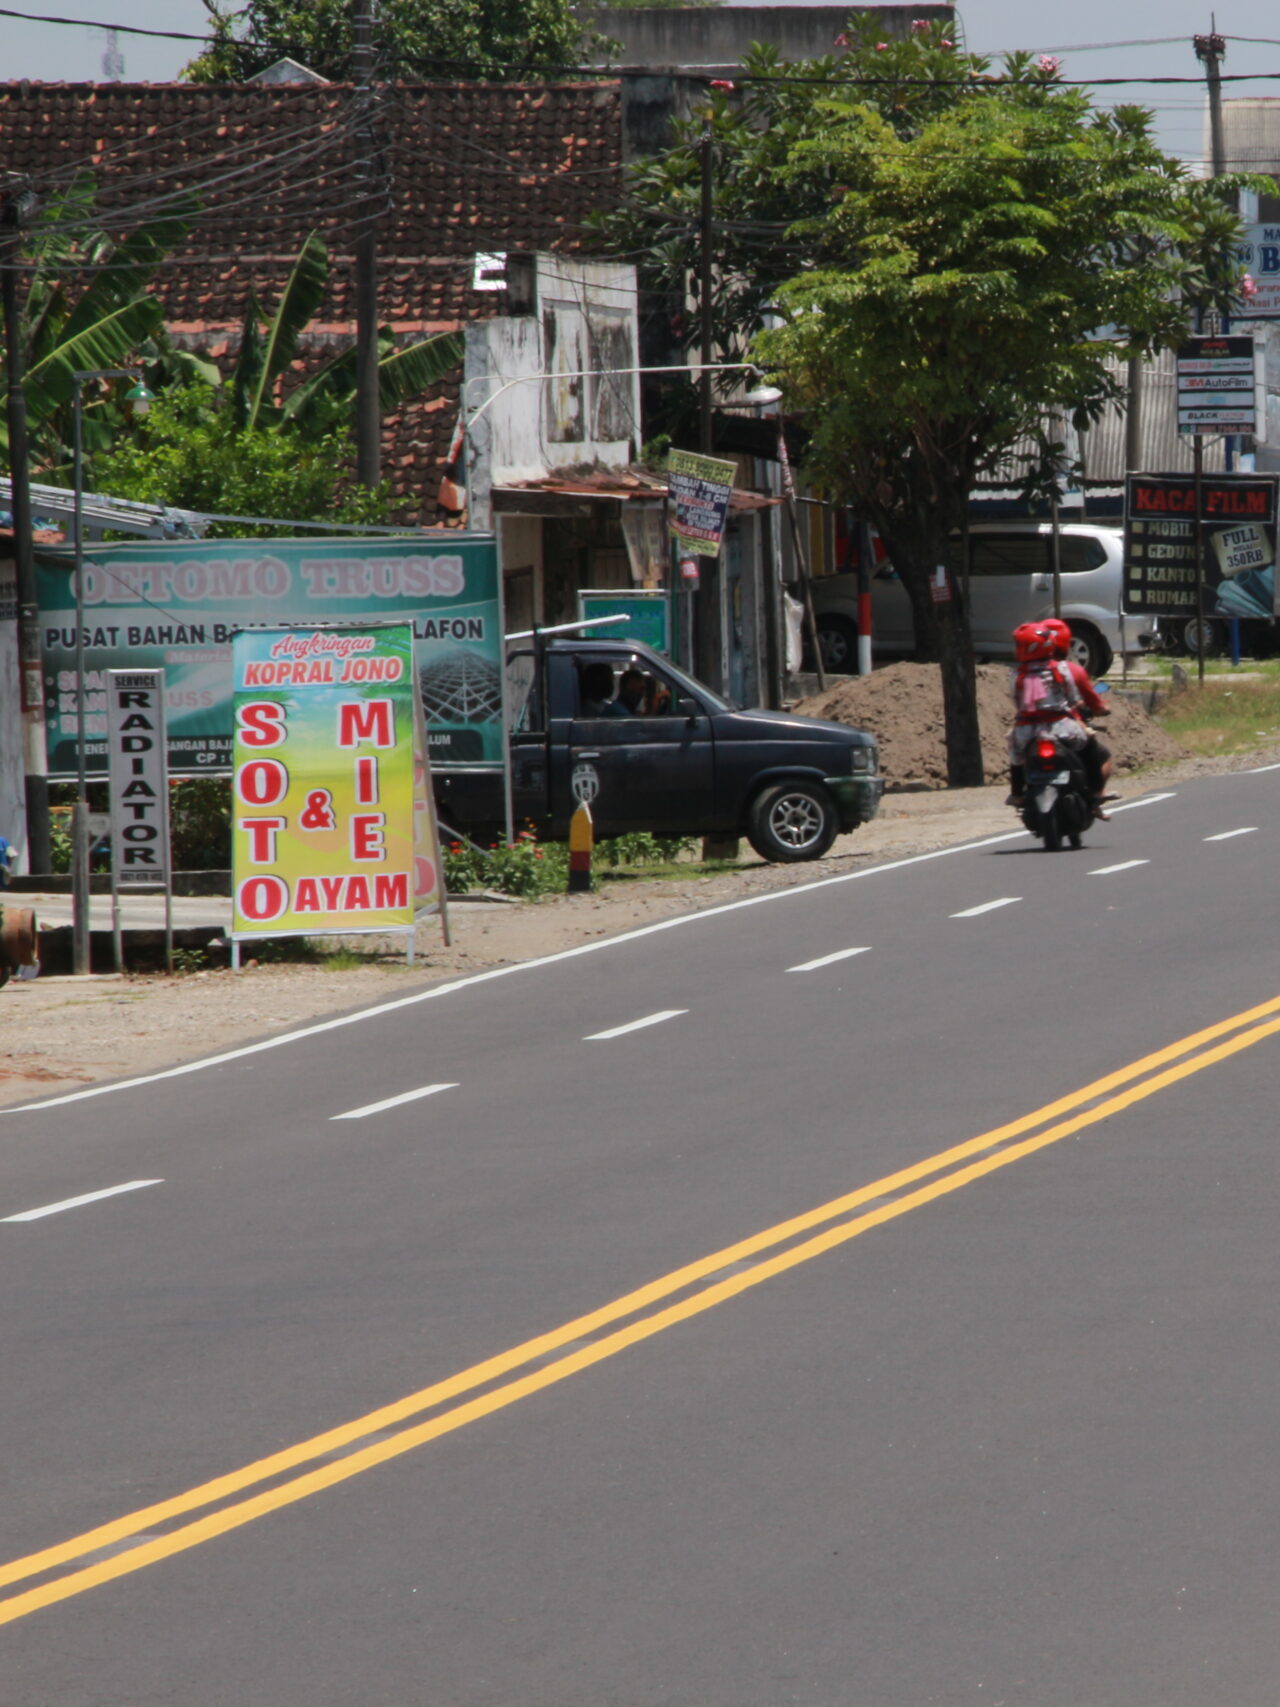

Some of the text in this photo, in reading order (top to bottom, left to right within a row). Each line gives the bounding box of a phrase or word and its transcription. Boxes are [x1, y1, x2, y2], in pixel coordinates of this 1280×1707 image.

[1136, 488, 1267, 513] KACA FILM
[1148, 522, 1194, 537] MOBIL
[1221, 528, 1260, 547] FULL
[301, 555, 463, 598] TRUSS
[46, 626, 120, 648] PUSAT
[128, 625, 205, 645] BAHAN
[412, 618, 483, 639] LAFON
[271, 632, 373, 659] Angkringan
[115, 675, 156, 687] SERVICE
[244, 657, 403, 685] KOPRAL JONO
[119, 691, 158, 864] RADIATOR
[340, 701, 391, 859] MIE
[240, 703, 282, 919] SOTO
[294, 874, 408, 912] AYAM
